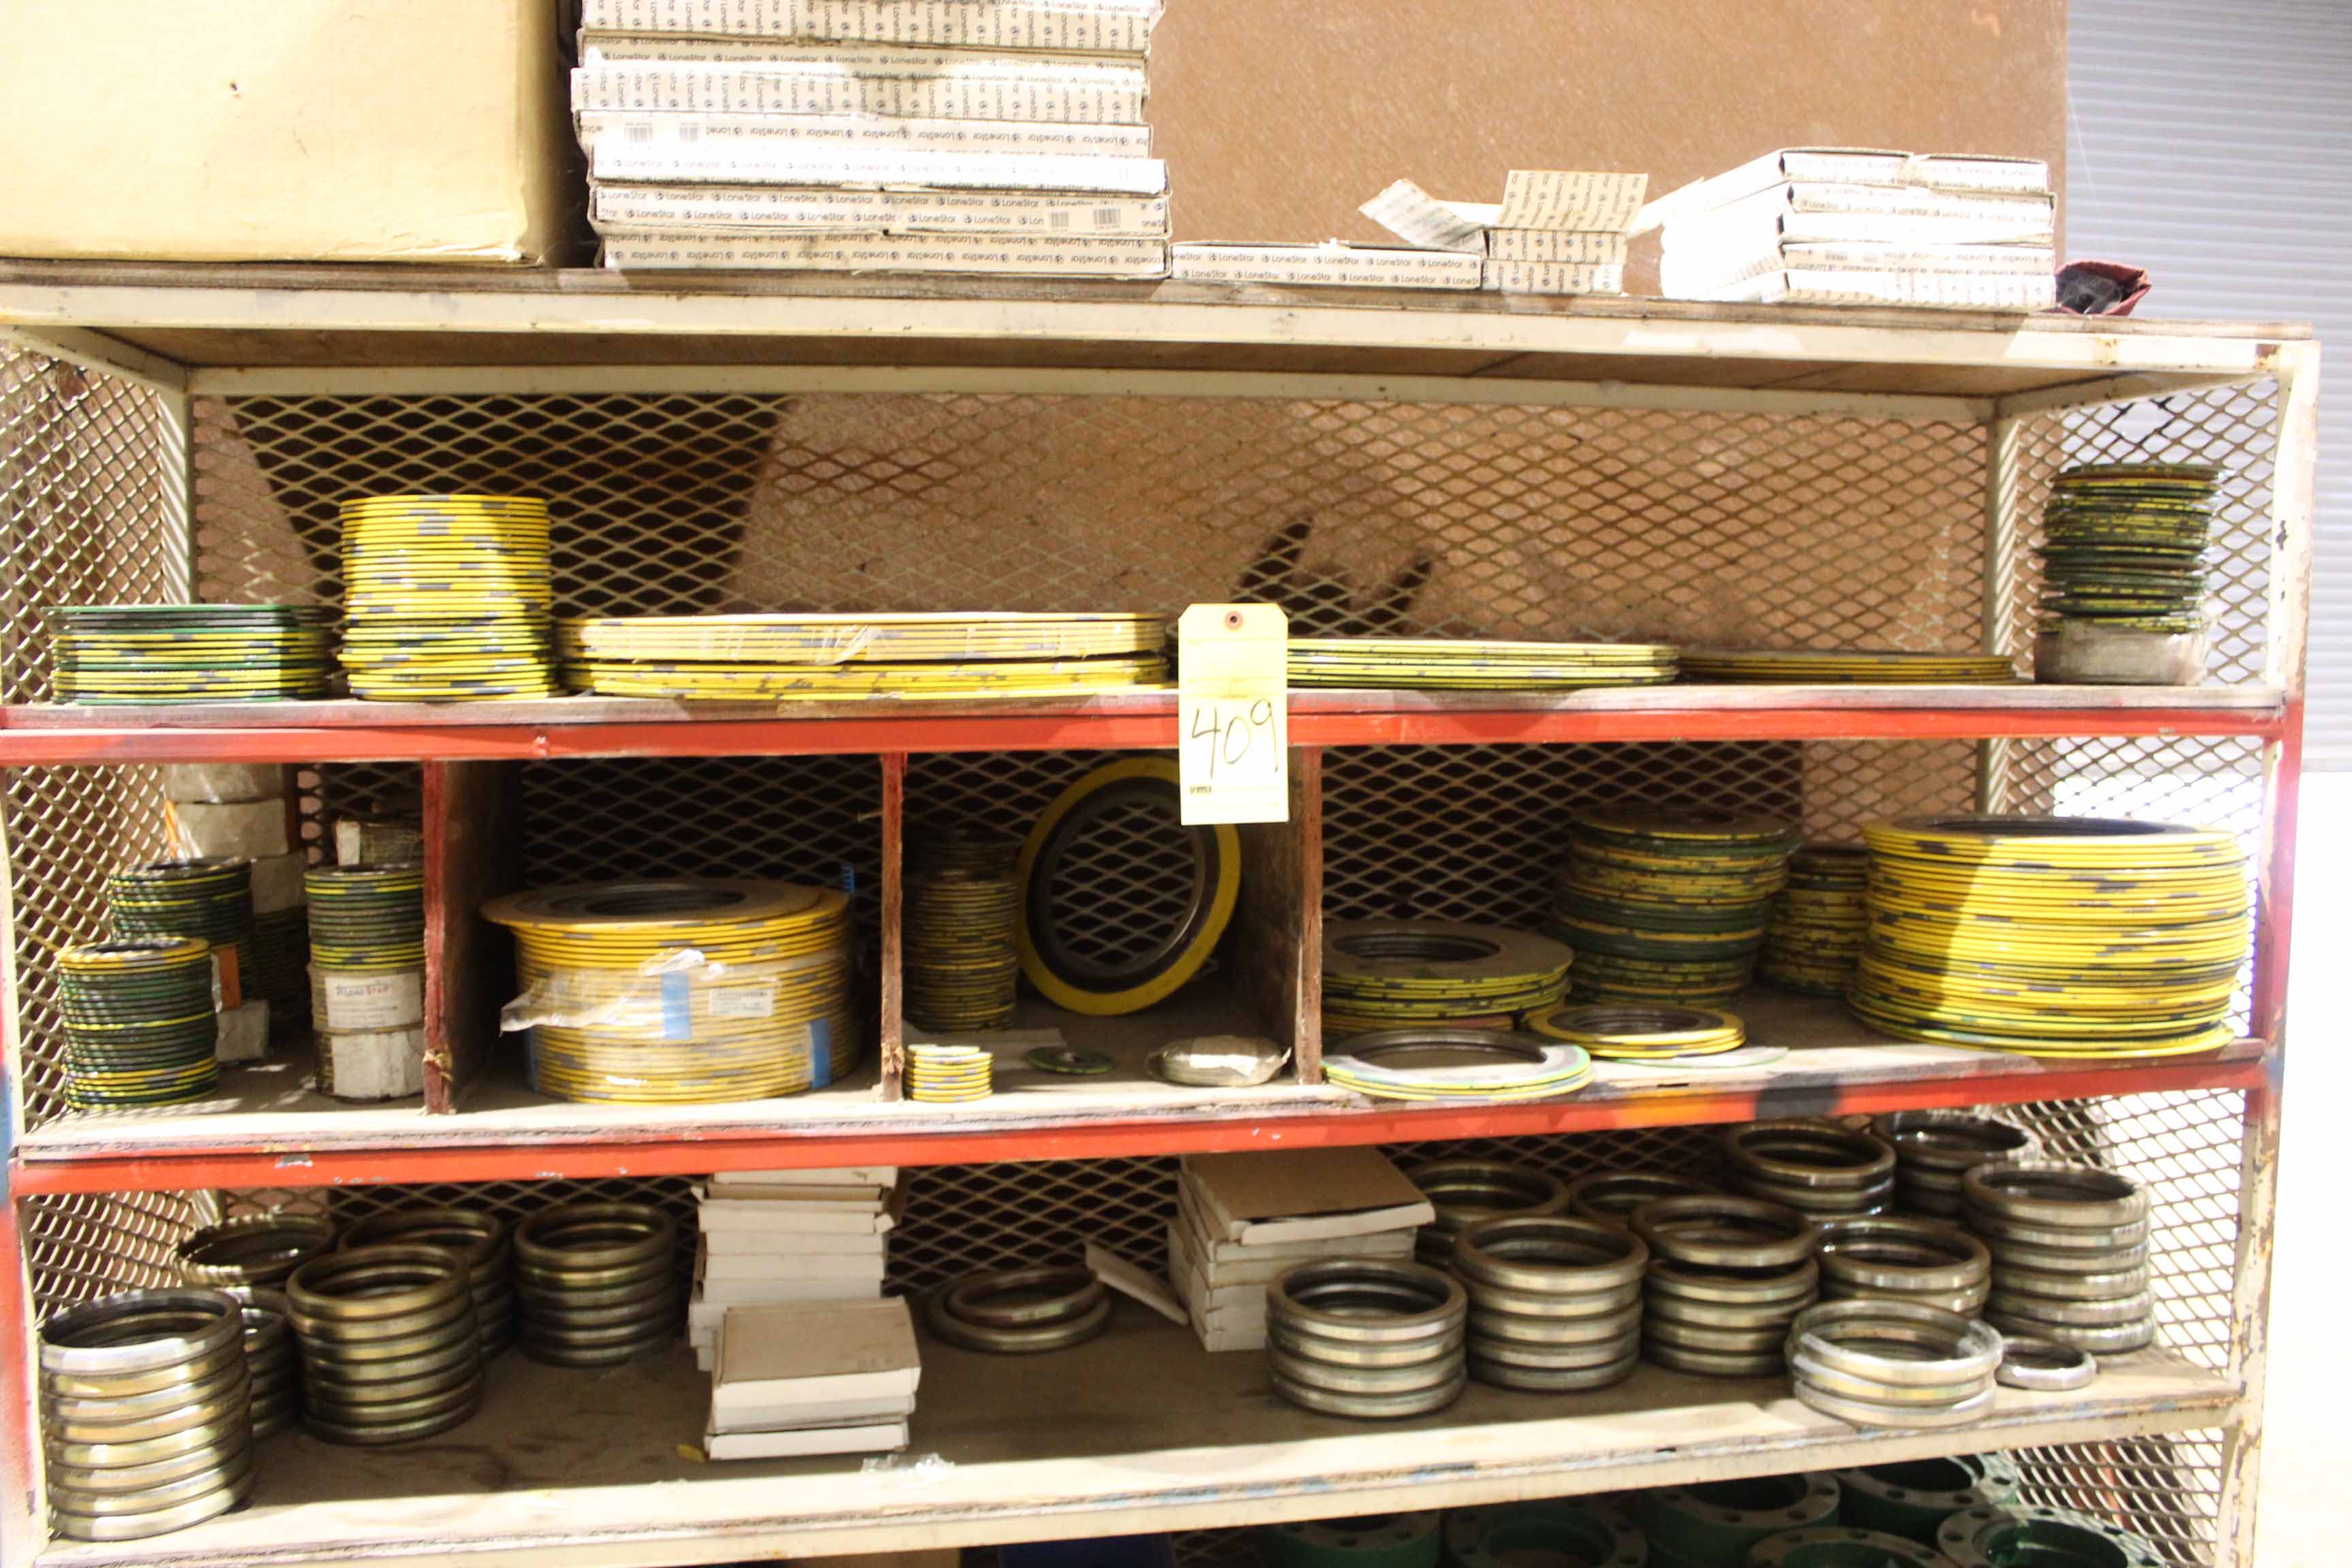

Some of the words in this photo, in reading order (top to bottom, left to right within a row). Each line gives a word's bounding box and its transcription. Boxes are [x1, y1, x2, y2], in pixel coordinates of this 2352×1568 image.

[806, 128, 844, 137] LoneStar
[973, 132, 1010, 142] LoneStar
[1027, 133, 1064, 142] LoneStar
[607, 191, 647, 201] LoneStar
[666, 193, 704, 201] LoneStar
[723, 193, 762, 202] LoneStar
[779, 195, 817, 203] LoneStar
[836, 195, 873, 203] LoneStar
[891, 196, 929, 204] LoneStar
[947, 197, 985, 206] LoneStar
[1002, 199, 1039, 207] LoneStar
[636, 210, 676, 218] LoneStar
[693, 210, 732, 219] LoneStar
[751, 212, 789, 220] LoneStar
[919, 214, 956, 223] LoneStar
[974, 215, 1011, 225] LoneStar
[631, 251, 668, 260] LoneStar
[686, 251, 723, 260] LoneStar
[741, 251, 779, 260] LoneStar
[796, 252, 834, 261] LoneStar
[851, 252, 888, 261] LoneStar
[906, 252, 943, 261] LoneStar
[962, 253, 998, 262] LoneStar
[1016, 254, 1054, 263] LoneStar
[1070, 255, 1107, 263] LoneStar
[1124, 256, 1161, 264] LoneStar
[1218, 254, 1254, 262] LoneStar
[1271, 255, 1307, 263] LoneStar
[1324, 256, 1360, 265] LoneStar
[1376, 257, 1411, 266] LoneStar
[1428, 259, 1463, 267] LoneStar
[1191, 270, 1226, 278] LoneStar
[1243, 270, 1280, 279] LoneStar
[1296, 272, 1331, 280] LoneStar
[1349, 273, 1385, 282] LoneStar
[1400, 274, 1436, 283] LoneStar
[1191, 698, 1279, 781] 409
